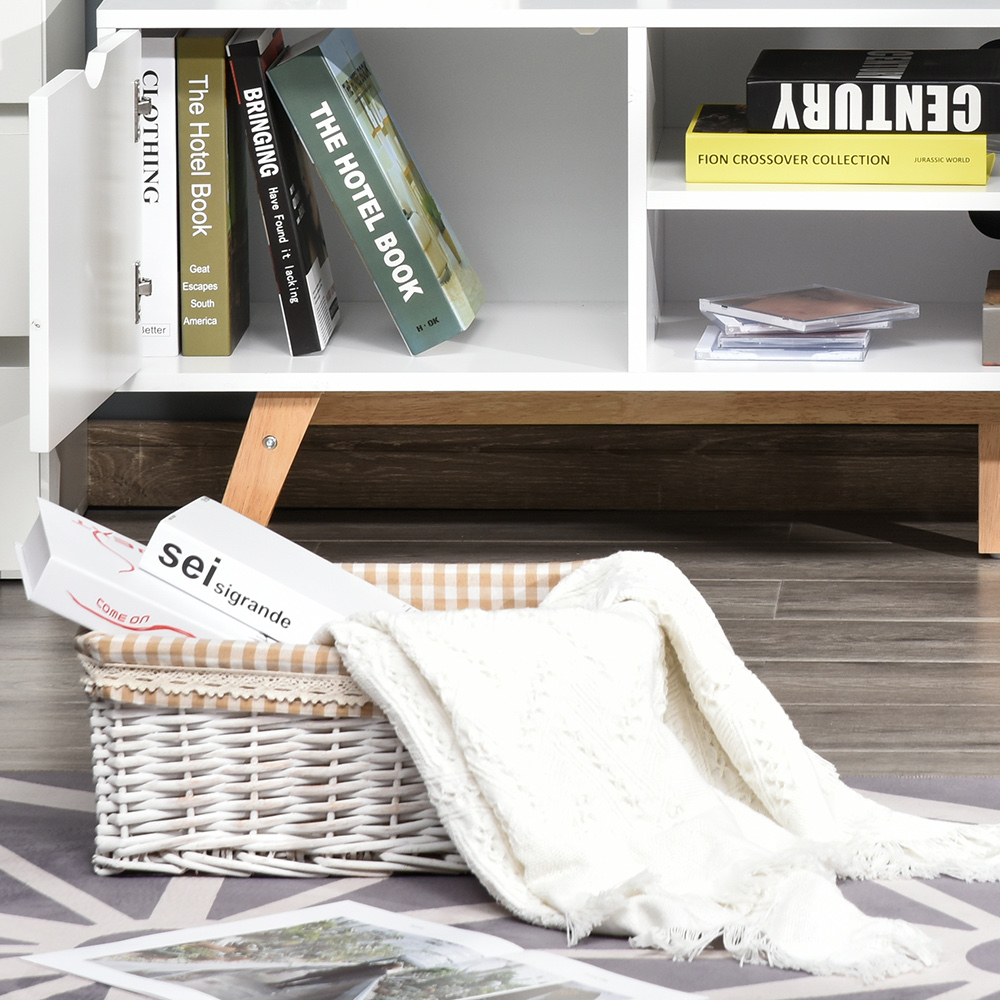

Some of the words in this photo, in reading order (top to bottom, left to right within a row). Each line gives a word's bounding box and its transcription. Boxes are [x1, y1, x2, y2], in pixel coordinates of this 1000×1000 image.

[188, 74, 209, 115] The
[772, 83, 982, 133] CENTURY
[189, 122, 211, 176] Hotel
[243, 86, 280, 178] BRINGING
[698, 154, 729, 166] FION
[732, 154, 808, 166] CROSSOVER
[812, 154, 890, 166] COLLECTION
[190, 184, 212, 236] Book
[268, 187, 279, 211] Have
[309, 101, 348, 154] THE
[333, 152, 385, 233] HOTEL
[374, 231, 424, 303] BOOK
[273, 214, 289, 243] Found
[189, 265, 210, 273] Geat
[281, 249, 291, 260] it
[182, 282, 218, 292] Escapes
[190, 299, 215, 308] South
[284, 265, 299, 304] lacking
[183, 316, 218, 326] America
[158, 542, 221, 587] sei
[213, 580, 291, 629] sigrande
